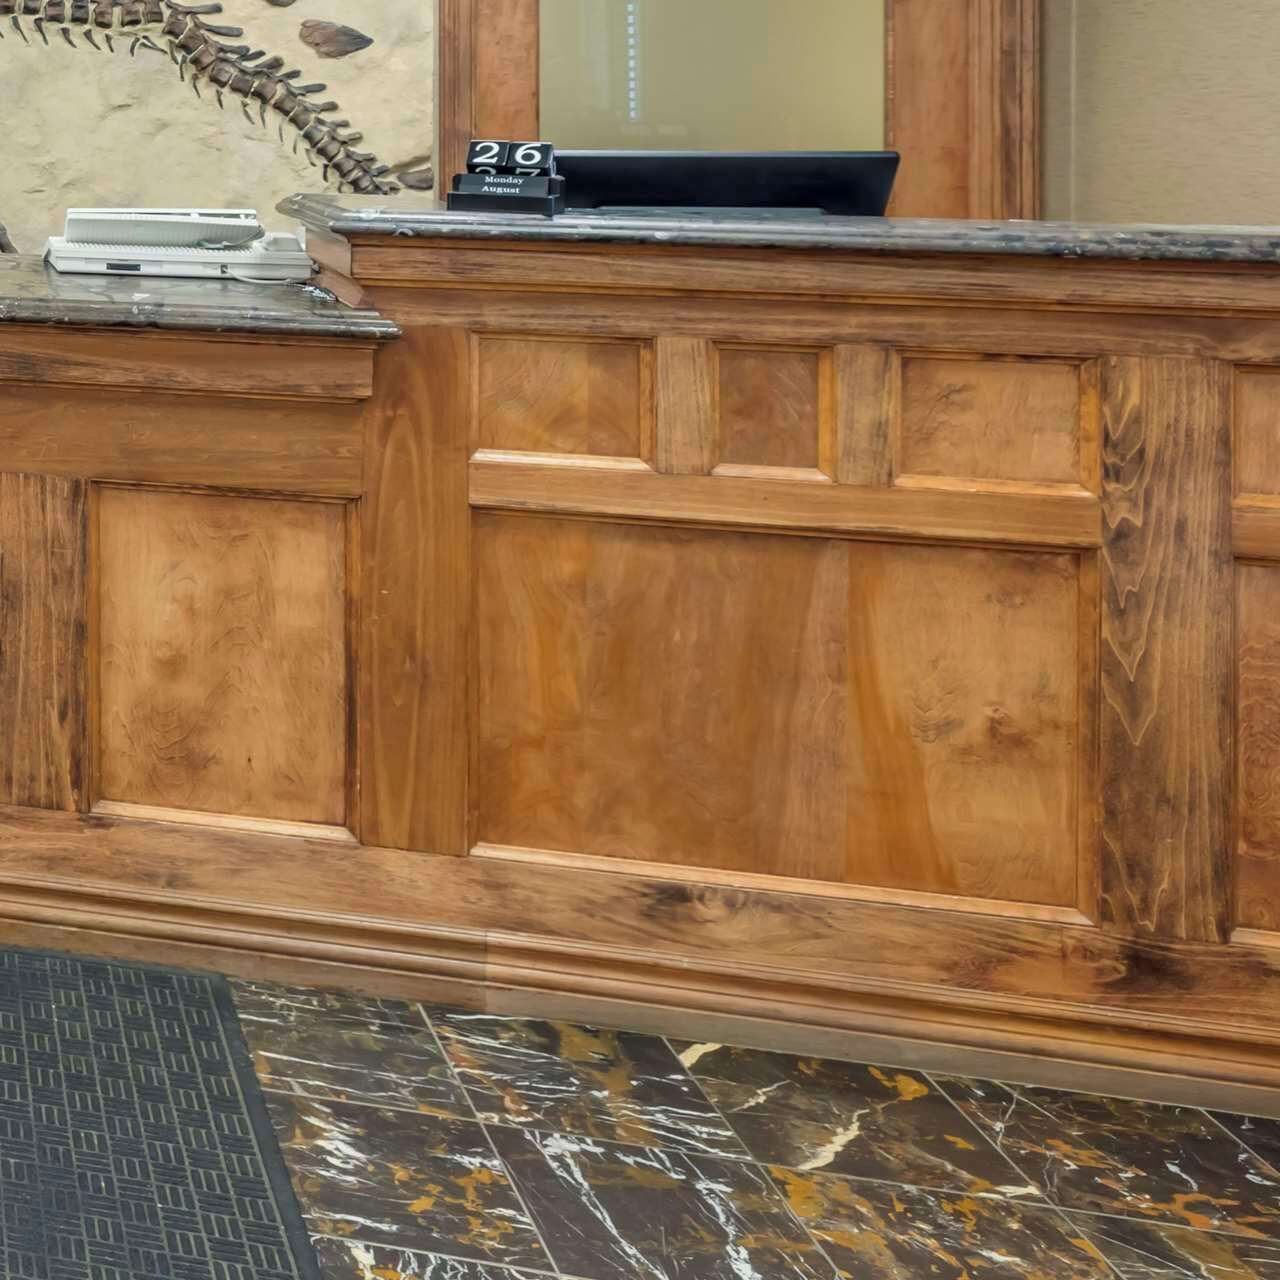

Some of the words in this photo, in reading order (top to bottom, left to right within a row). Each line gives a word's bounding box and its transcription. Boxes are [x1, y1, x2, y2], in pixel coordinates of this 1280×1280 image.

[472, 142, 542, 165] 26
[484, 175, 524, 185] Monday
[481, 185, 520, 194] August
